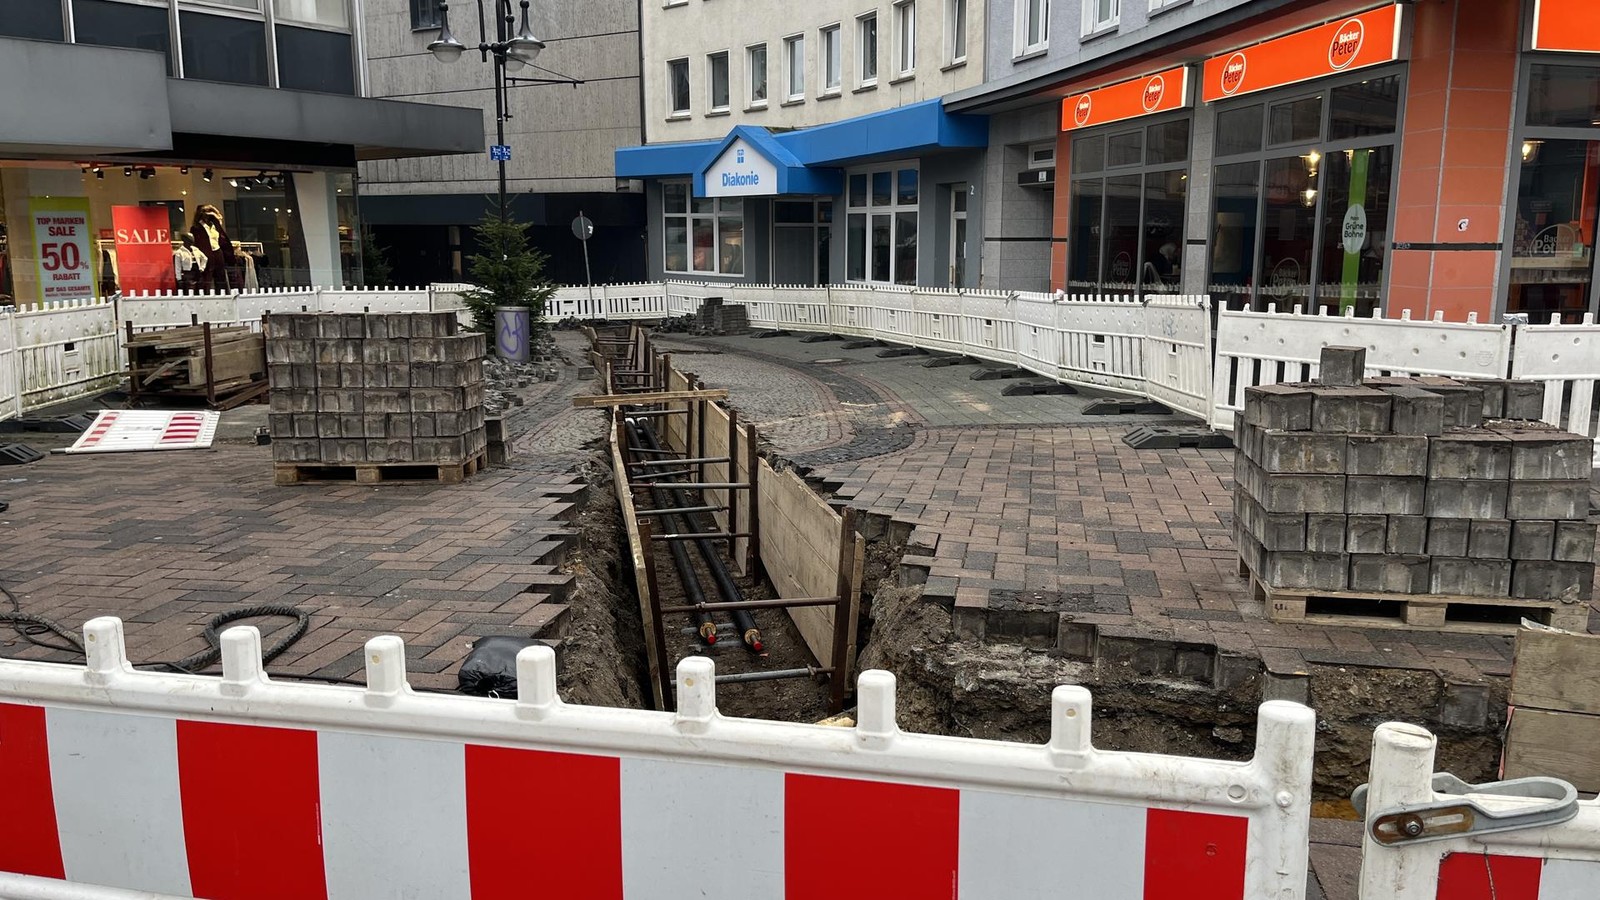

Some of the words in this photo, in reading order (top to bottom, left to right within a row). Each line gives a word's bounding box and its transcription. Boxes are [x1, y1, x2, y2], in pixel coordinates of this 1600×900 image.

[1332, 40, 1358, 57] Peter
[1224, 70, 1242, 84] Peter
[1145, 90, 1160, 102] Peter
[722, 170, 759, 186] Diakonie
[970, 185, 974, 195] 2
[48, 226, 76, 236] SALE
[1345, 222, 1364, 230] Grüne
[117, 229, 169, 244] SALE
[53, 273, 80, 281] RABATT
